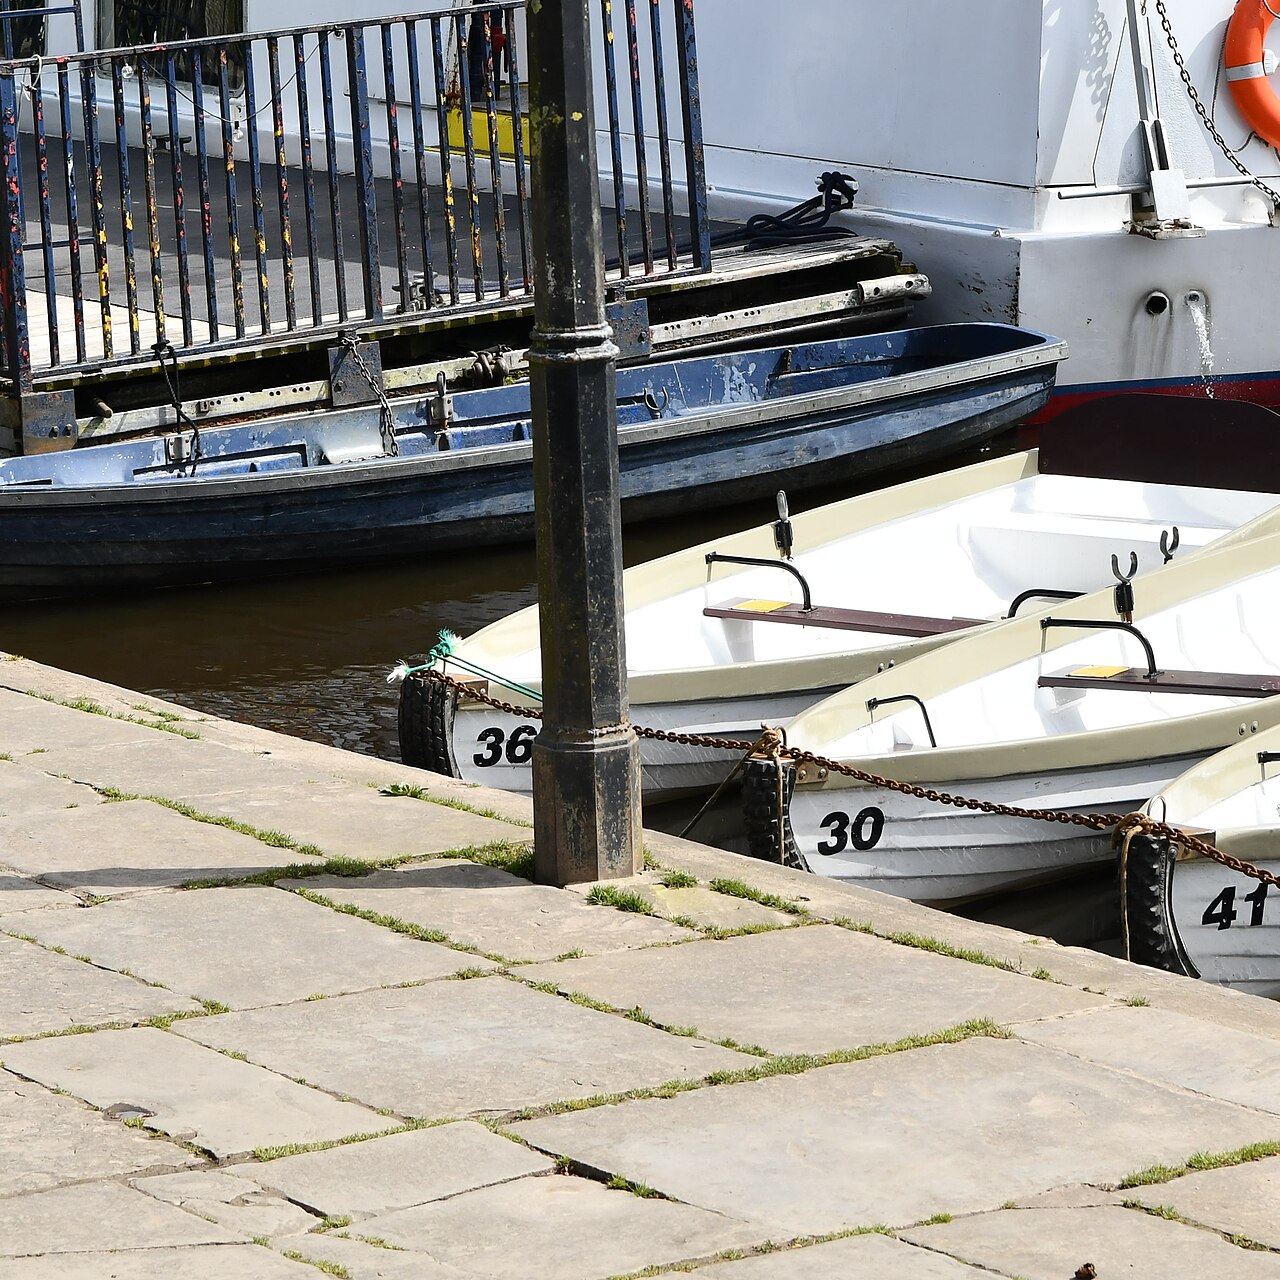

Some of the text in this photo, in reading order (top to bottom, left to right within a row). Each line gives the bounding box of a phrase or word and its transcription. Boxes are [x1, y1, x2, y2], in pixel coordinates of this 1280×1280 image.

[473, 725, 538, 767] 36
[816, 806, 886, 856] 30
[1201, 881, 1269, 930] 41
